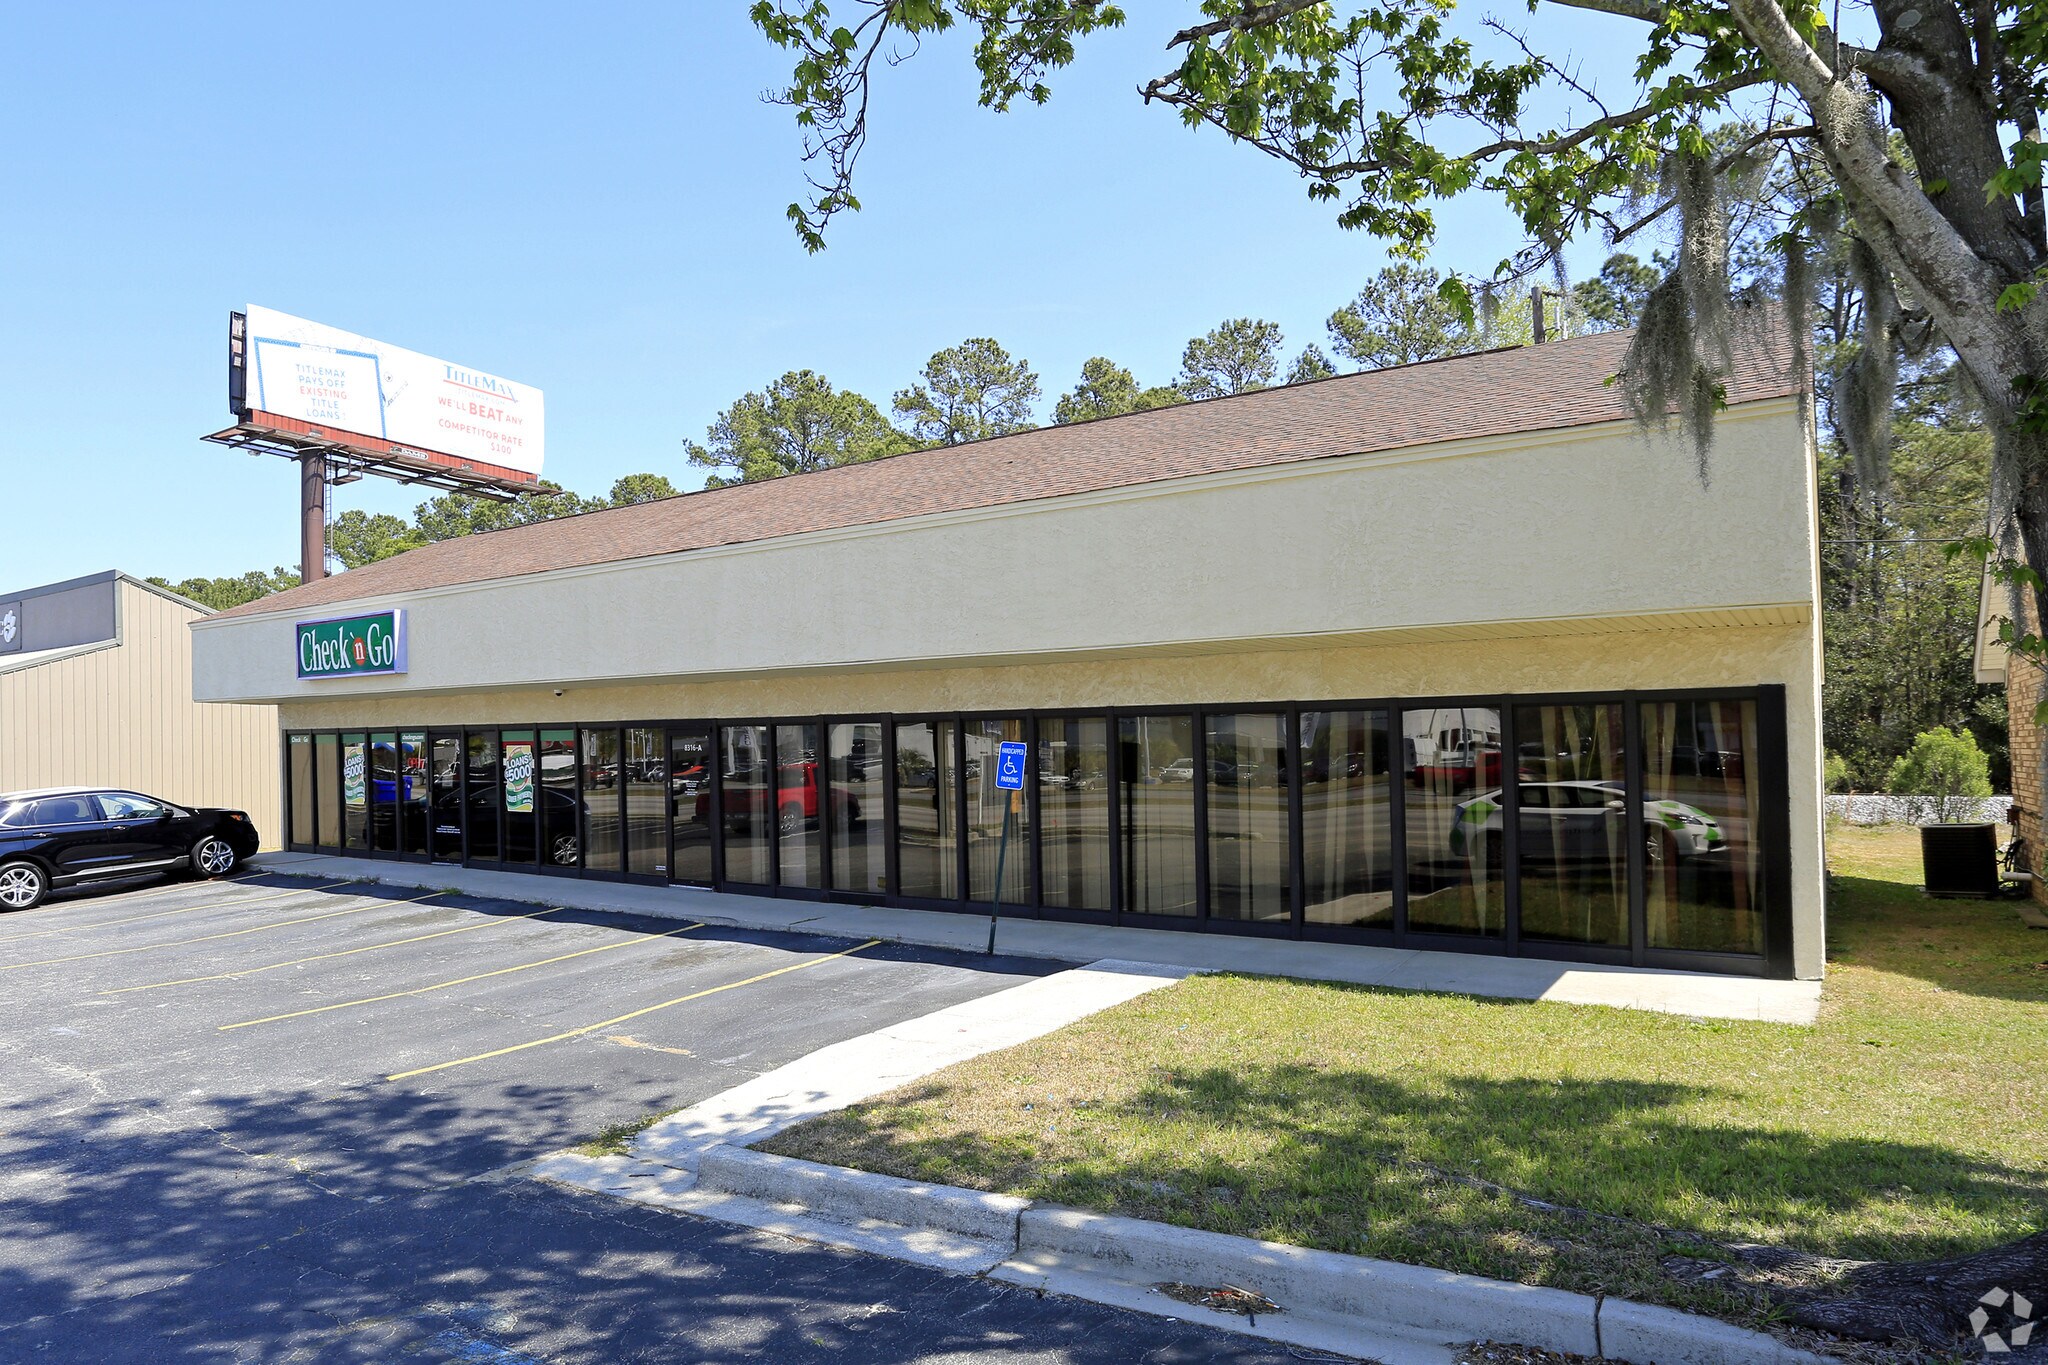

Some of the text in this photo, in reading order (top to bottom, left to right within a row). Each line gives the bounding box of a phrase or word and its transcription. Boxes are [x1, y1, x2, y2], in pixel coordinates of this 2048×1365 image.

[296, 364, 346, 378] TITLEMAX
[299, 375, 345, 388] PAYS OFF
[300, 386, 347, 400] EXISTING
[311, 398, 340, 409] TITLE
[438, 396, 524, 426] WE'LL BEAT ANY
[438, 418, 524, 447] COMPETITOR RATE
[300, 626, 352, 672] Check
[367, 623, 394, 667] Go
[507, 754, 530, 769] LOANS
[505, 764, 531, 782] $5000
[1001, 775, 1019, 784] PARKING
